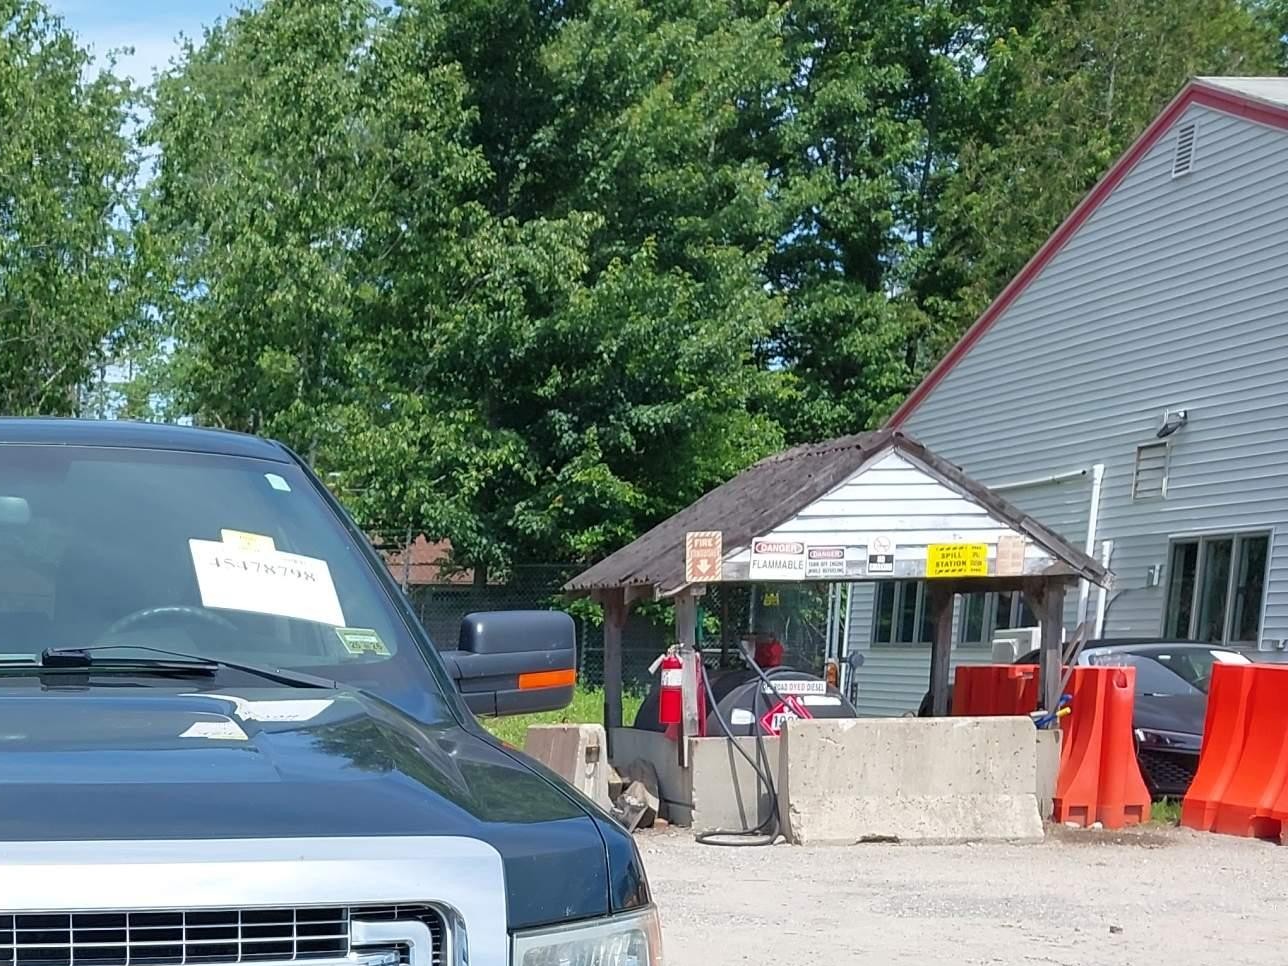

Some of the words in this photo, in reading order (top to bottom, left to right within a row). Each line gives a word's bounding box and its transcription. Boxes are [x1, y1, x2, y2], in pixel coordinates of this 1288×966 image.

[694, 538, 713, 547] FIRE
[761, 543, 797, 553] DANGER
[752, 560, 804, 570] FLAMMABLE
[936, 560, 967, 568] STATION
